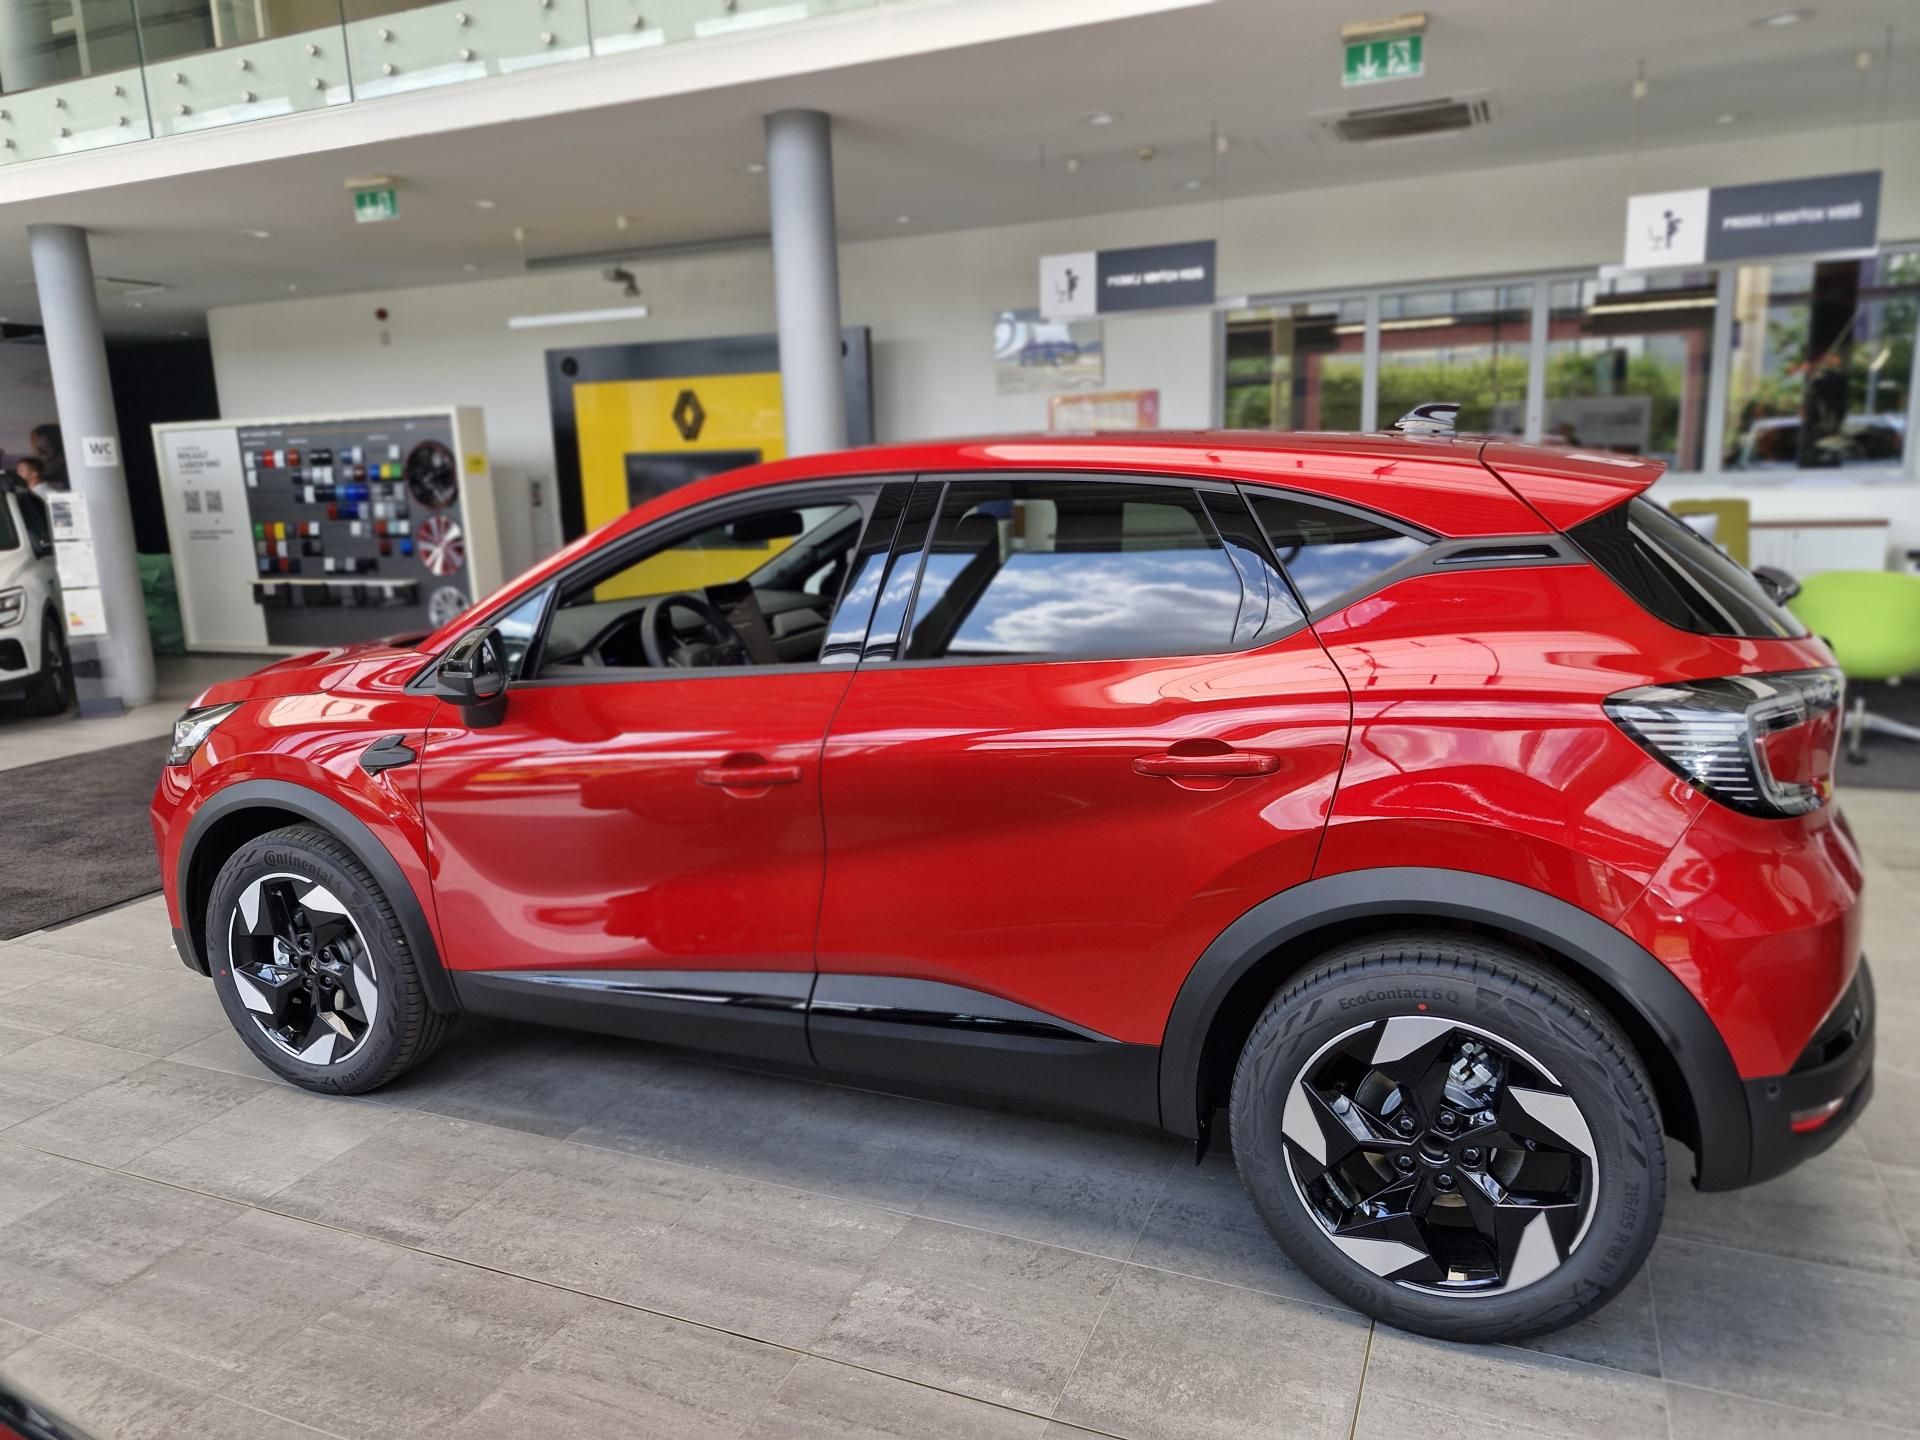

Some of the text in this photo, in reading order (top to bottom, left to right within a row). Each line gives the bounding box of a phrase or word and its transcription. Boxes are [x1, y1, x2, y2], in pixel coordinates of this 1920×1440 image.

[89, 442, 111, 455] WC
[263, 850, 334, 886] Continental
[1338, 987, 1460, 1010] EcoContact 6 Q
